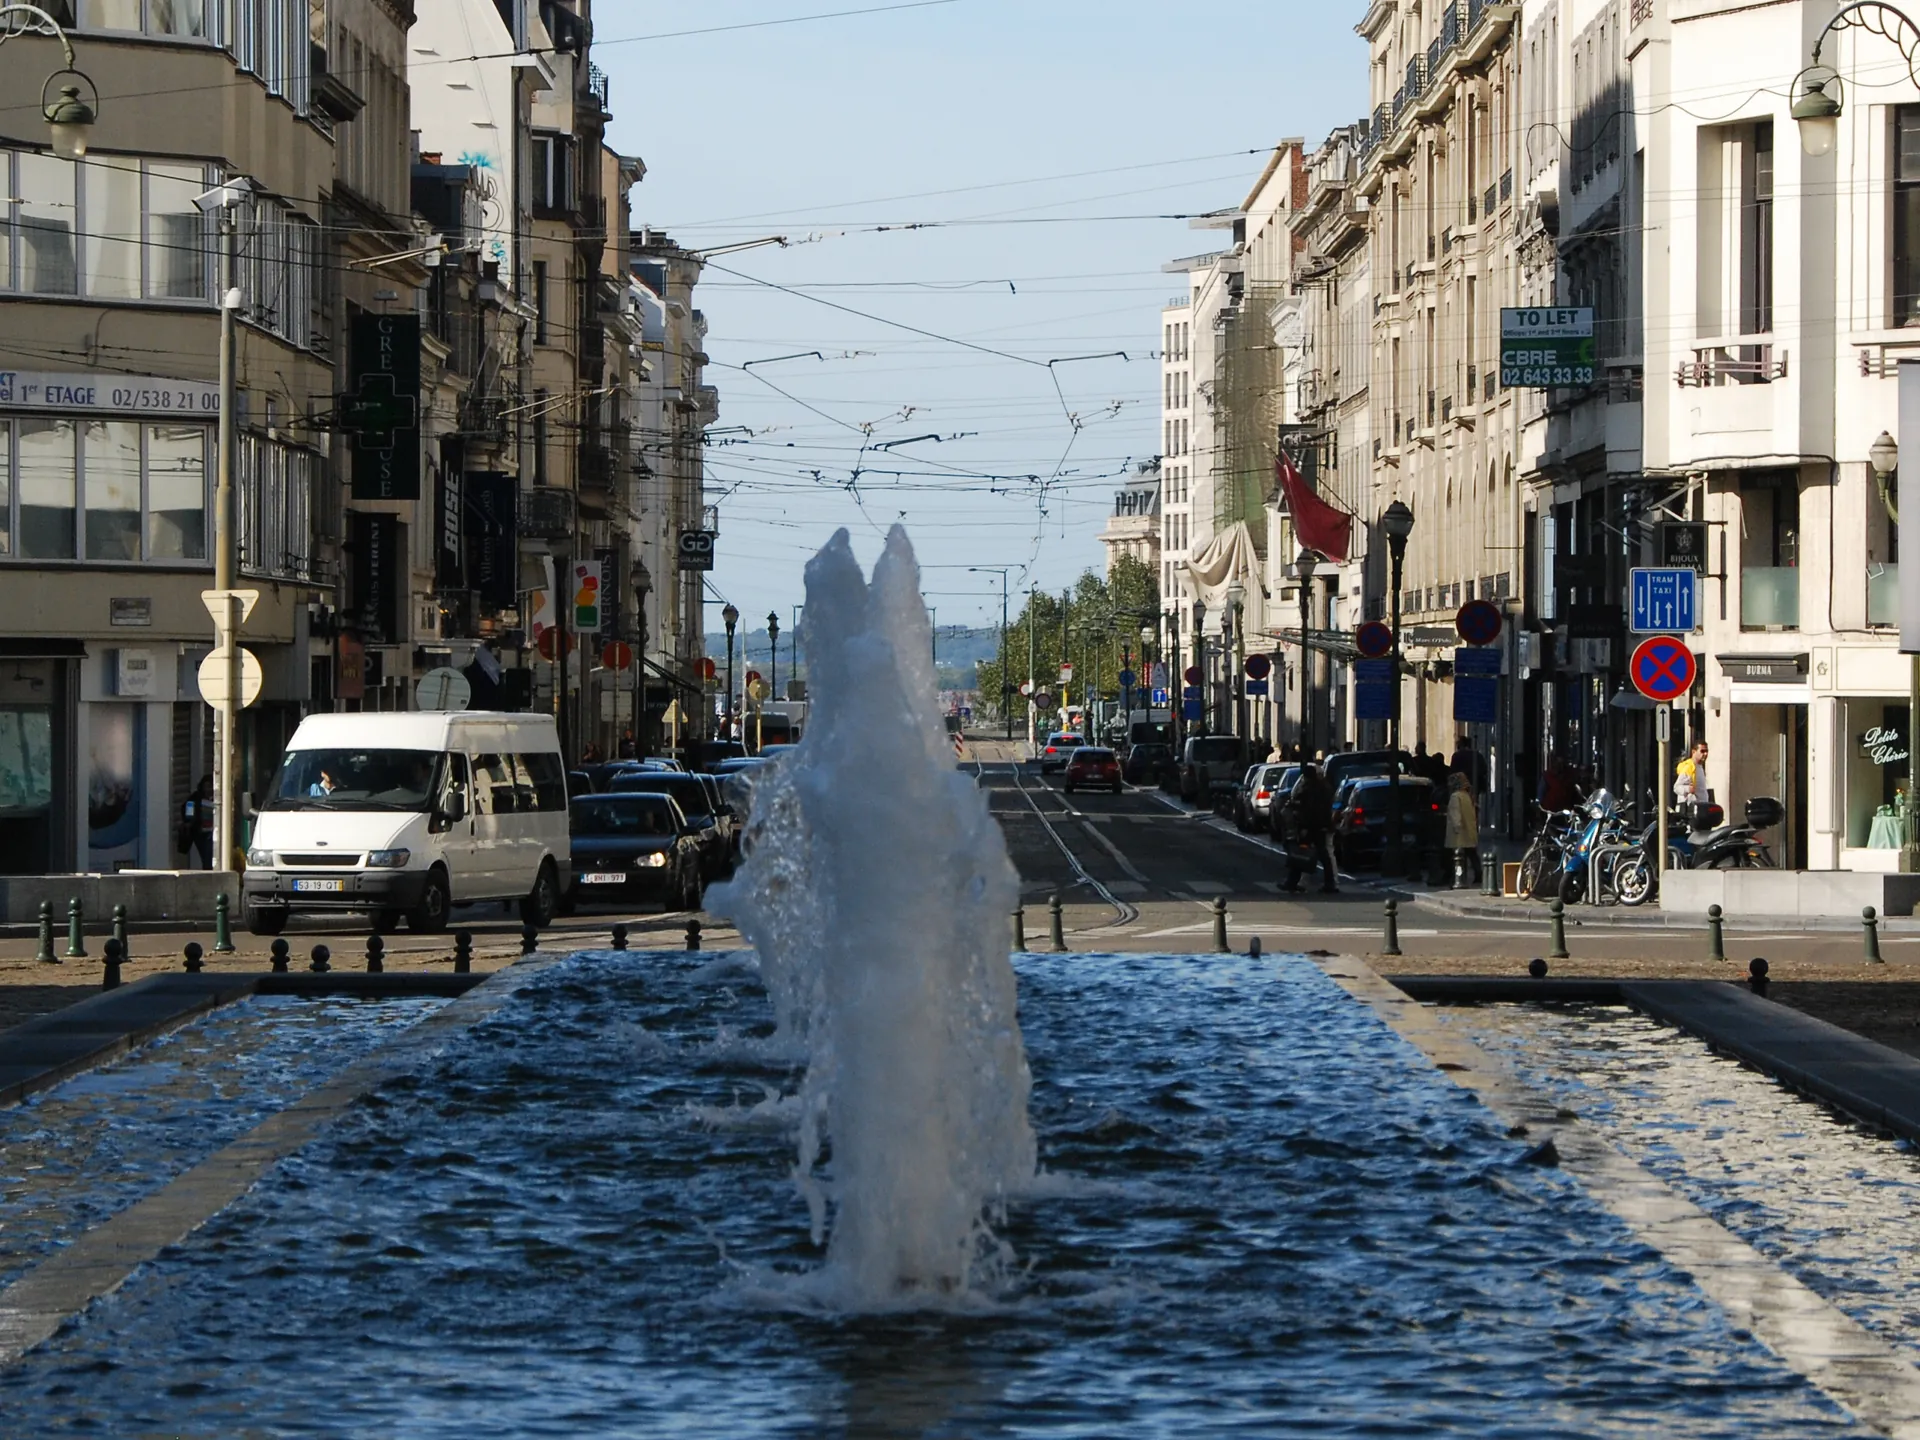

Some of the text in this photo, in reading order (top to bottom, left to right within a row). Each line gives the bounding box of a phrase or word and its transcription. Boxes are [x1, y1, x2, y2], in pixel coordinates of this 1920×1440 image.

[1516, 310, 1579, 326] TO LET
[1502, 350, 1557, 366] CBRE
[1502, 367, 1593, 385] 02 643 33 33
[45, 386, 95, 405] ETAGE
[112, 389, 171, 409] 02/538
[177, 391, 194, 410] 21
[201, 392, 220, 410] 00
[445, 460, 459, 567] BOSE
[1670, 555, 1699, 563] BIJOUX
[1652, 576, 1674, 584] TRAM
[1653, 587, 1672, 595] TAXI
[1746, 664, 1772, 675] BURMA
[1863, 726, 1899, 748] Petite
[1870, 745, 1909, 765] Chérie
